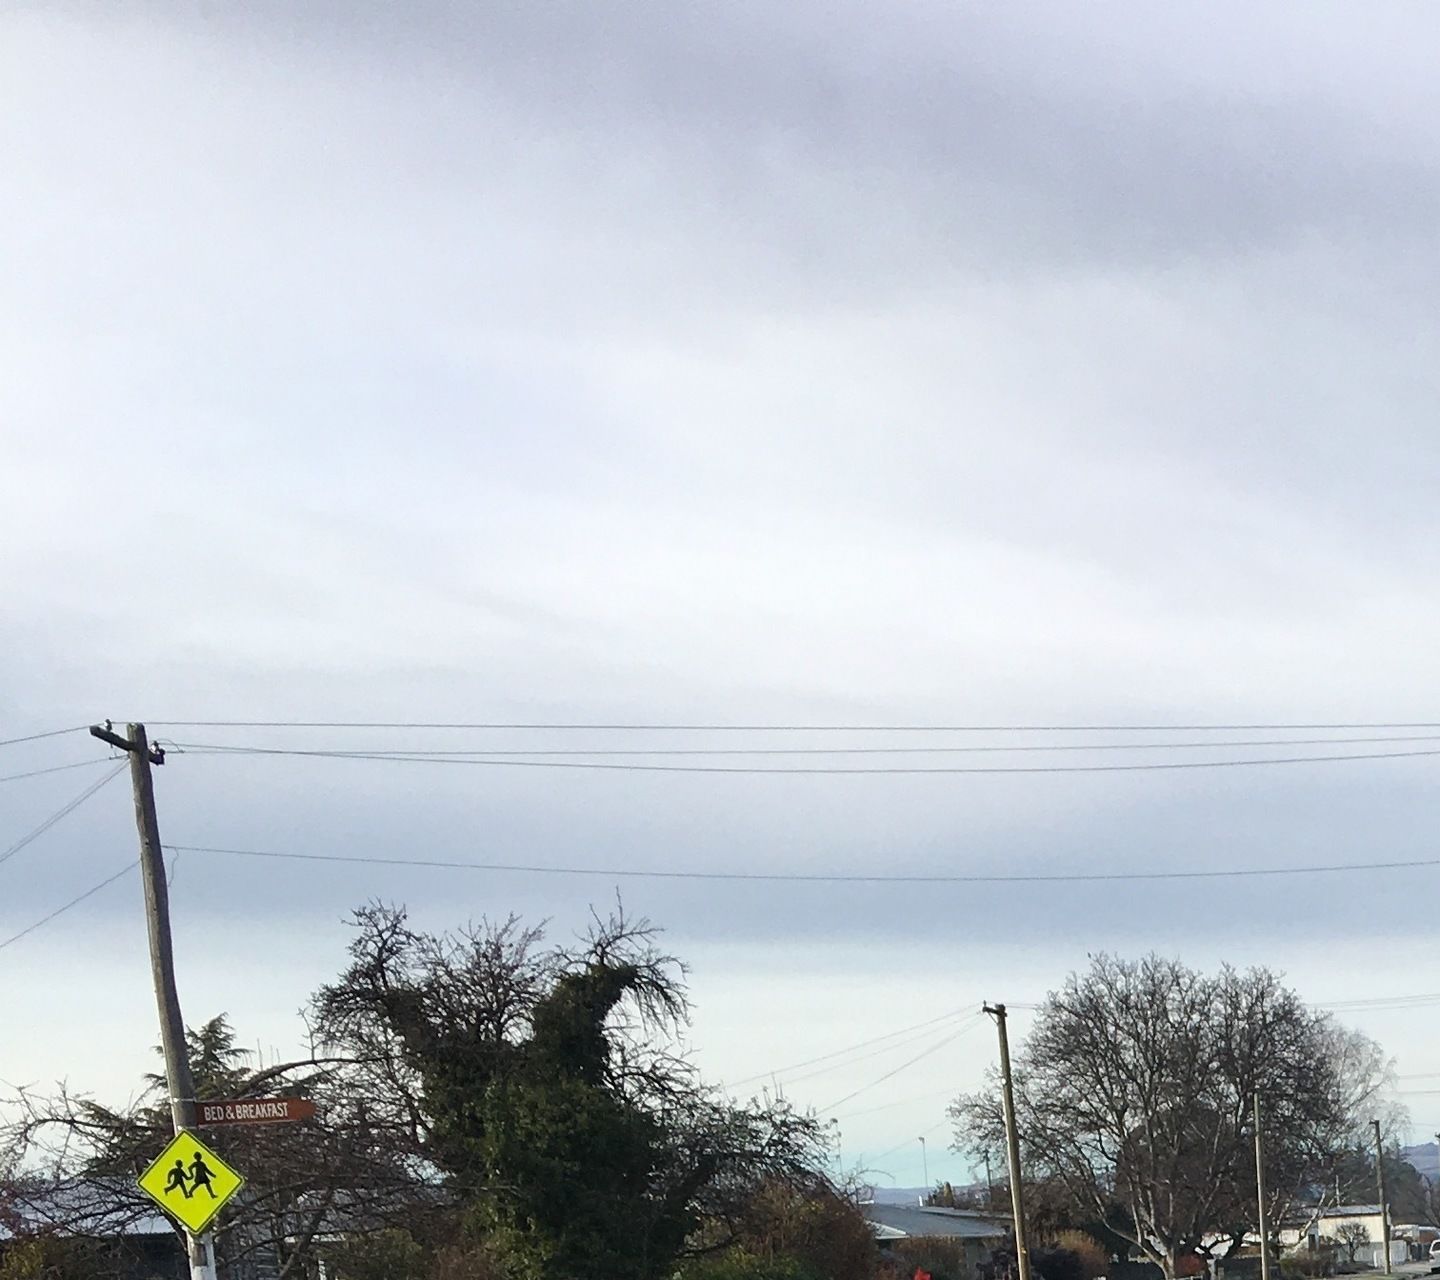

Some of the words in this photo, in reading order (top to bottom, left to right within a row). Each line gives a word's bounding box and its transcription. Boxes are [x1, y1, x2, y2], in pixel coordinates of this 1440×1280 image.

[204, 1106, 224, 1120] BED
[226, 1105, 235, 1119] &
[235, 1102, 288, 1119] BREAKFAST
